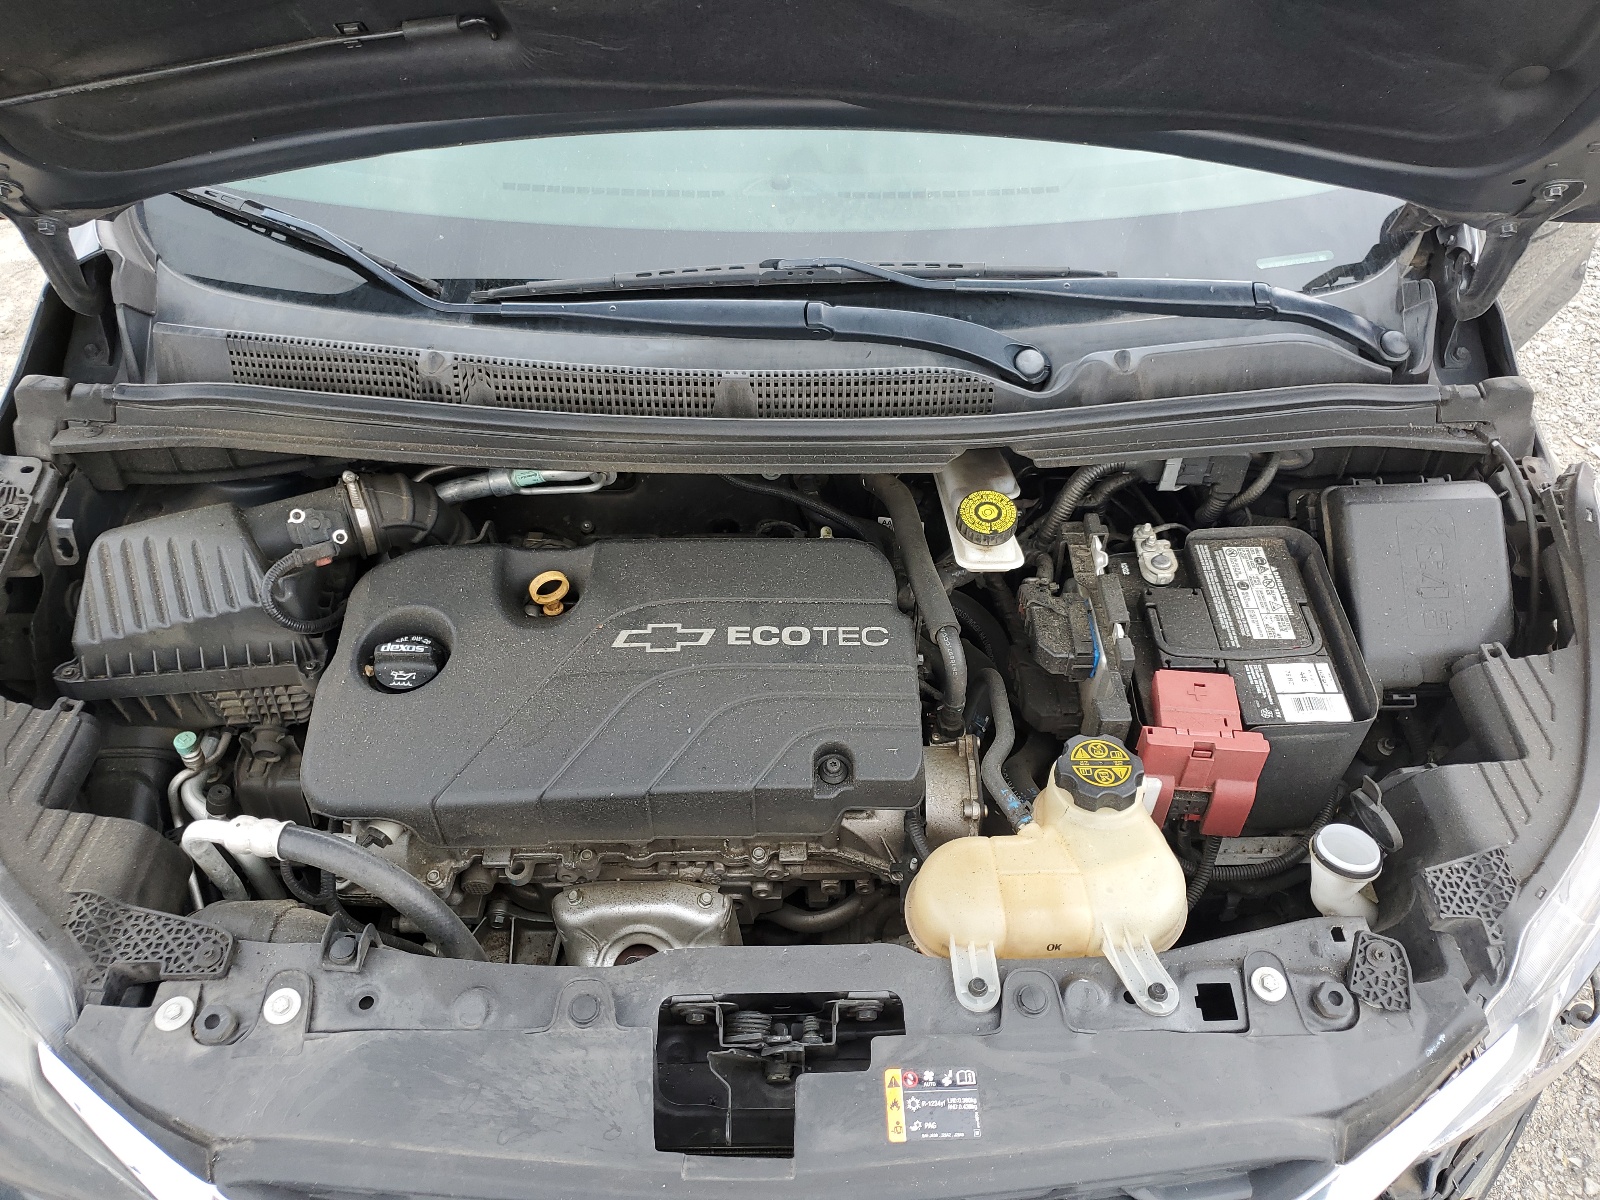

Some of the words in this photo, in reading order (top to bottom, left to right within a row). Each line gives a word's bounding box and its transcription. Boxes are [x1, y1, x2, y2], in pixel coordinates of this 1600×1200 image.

[727, 625, 889, 646] ECOTEC
[380, 642, 425, 653] dexos
[1046, 943, 1062, 952] OK
[924, 1121, 937, 1129] PAG
